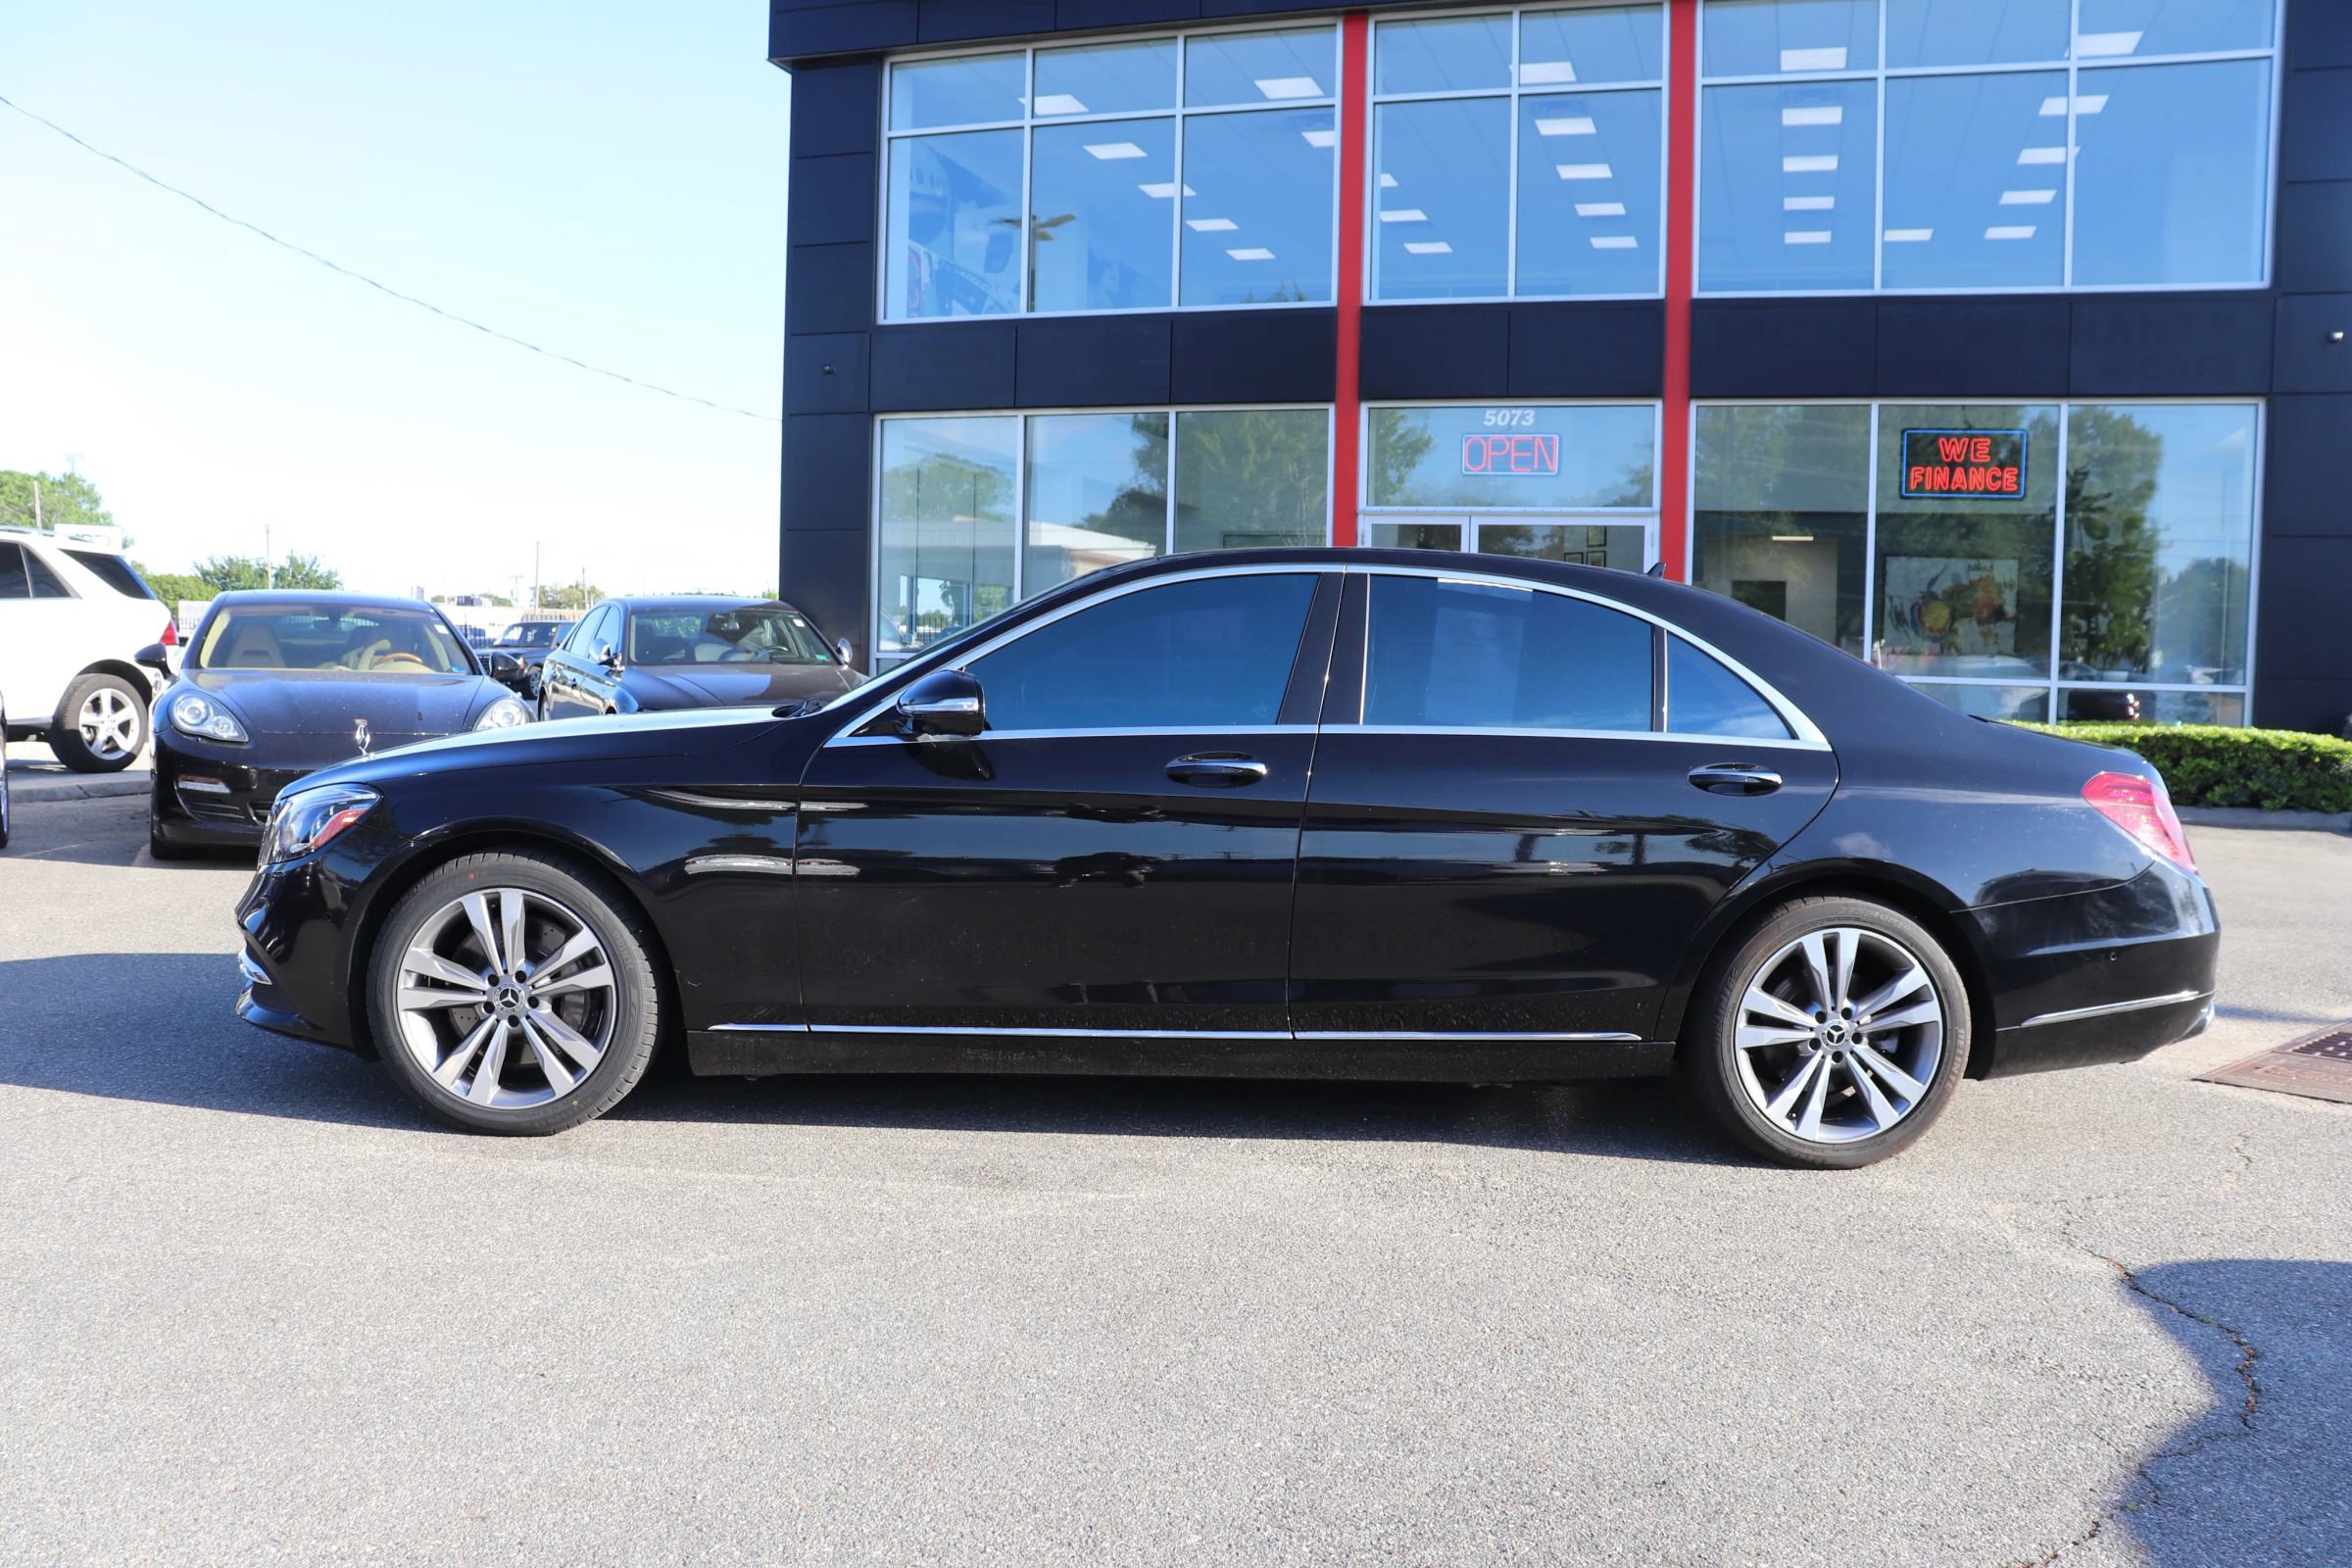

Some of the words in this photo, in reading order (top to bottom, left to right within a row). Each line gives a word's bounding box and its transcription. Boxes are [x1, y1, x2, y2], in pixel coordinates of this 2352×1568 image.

[1483, 409, 1536, 426] 5073
[1464, 436, 1558, 471] OPEN
[1938, 437, 1991, 463] WE
[1909, 466, 2019, 492] FINANCE
